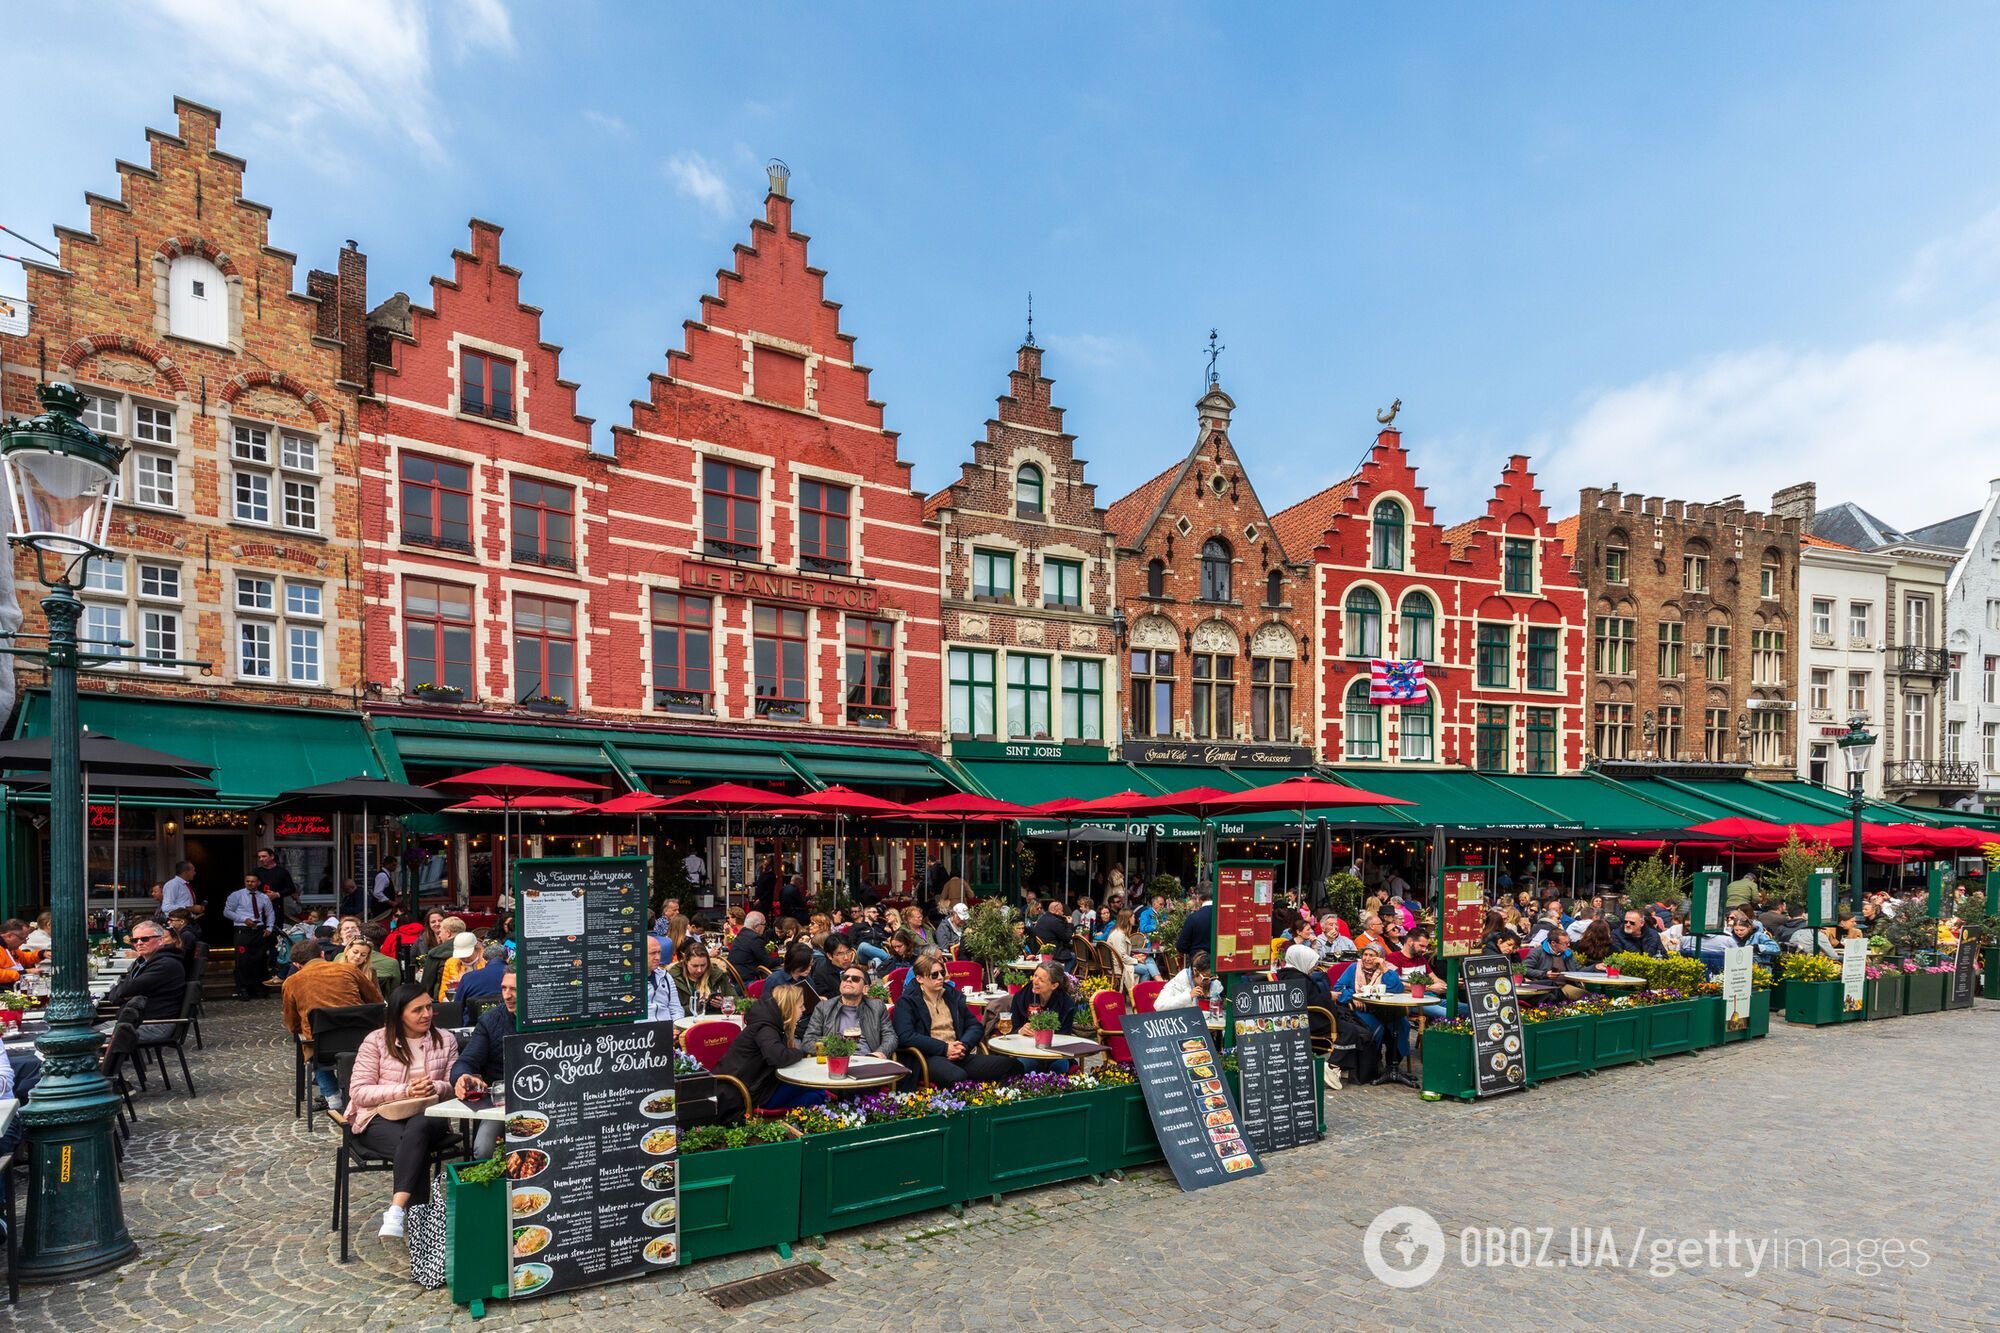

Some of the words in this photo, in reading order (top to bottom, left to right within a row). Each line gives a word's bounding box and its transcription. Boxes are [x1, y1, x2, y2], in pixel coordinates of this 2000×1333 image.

[690, 569, 721, 588] LE
[729, 571, 816, 601] PANIER
[823, 588, 873, 608] D'OR
[1006, 746, 1031, 756] SINT
[1033, 747, 1061, 757] JORIS
[1145, 749, 1170, 762] Grand
[1204, 746, 1237, 763] Central
[1252, 752, 1291, 762] Brasserie
[276, 823, 303, 834] Local
[305, 823, 330, 833] Beers
[1221, 824, 1244, 834] Hotel
[550, 872, 588, 881] Taverne
[590, 870, 633, 883] Brugeoise
[1258, 994, 1284, 1013] MENU
[1144, 1017, 1188, 1038] SNACKS
[524, 1038, 592, 1062] Today's
[597, 1030, 655, 1058] Special
[554, 1056, 604, 1084] Local
[612, 1051, 667, 1072] Dishes
[1144, 1061, 1173, 1070] SANDWICHES
[517, 1074, 544, 1093] €15
[1151, 1076, 1178, 1085] OMELETTEN
[583, 1090, 607, 1100] Flemish
[609, 1088, 635, 1097] Beefstew
[538, 1101, 556, 1110] Steak
[1159, 1106, 1188, 1116] HAMBURGER
[602, 1124, 614, 1134] Fish
[623, 1122, 639, 1131] Chips
[537, 1135, 574, 1149] Spare-ribs
[1177, 1137, 1200, 1146] SALADES
[600, 1165, 624, 1176] Mussels
[1196, 1166, 1214, 1175] VEGGIE
[554, 1176, 592, 1188] Hamburger
[598, 1202, 628, 1214] Waterzooi
[547, 1212, 570, 1222] Salmon
[611, 1236, 633, 1247] Rabbit
[544, 1252, 568, 1263] Chicken
[571, 1248, 584, 1258] stew
